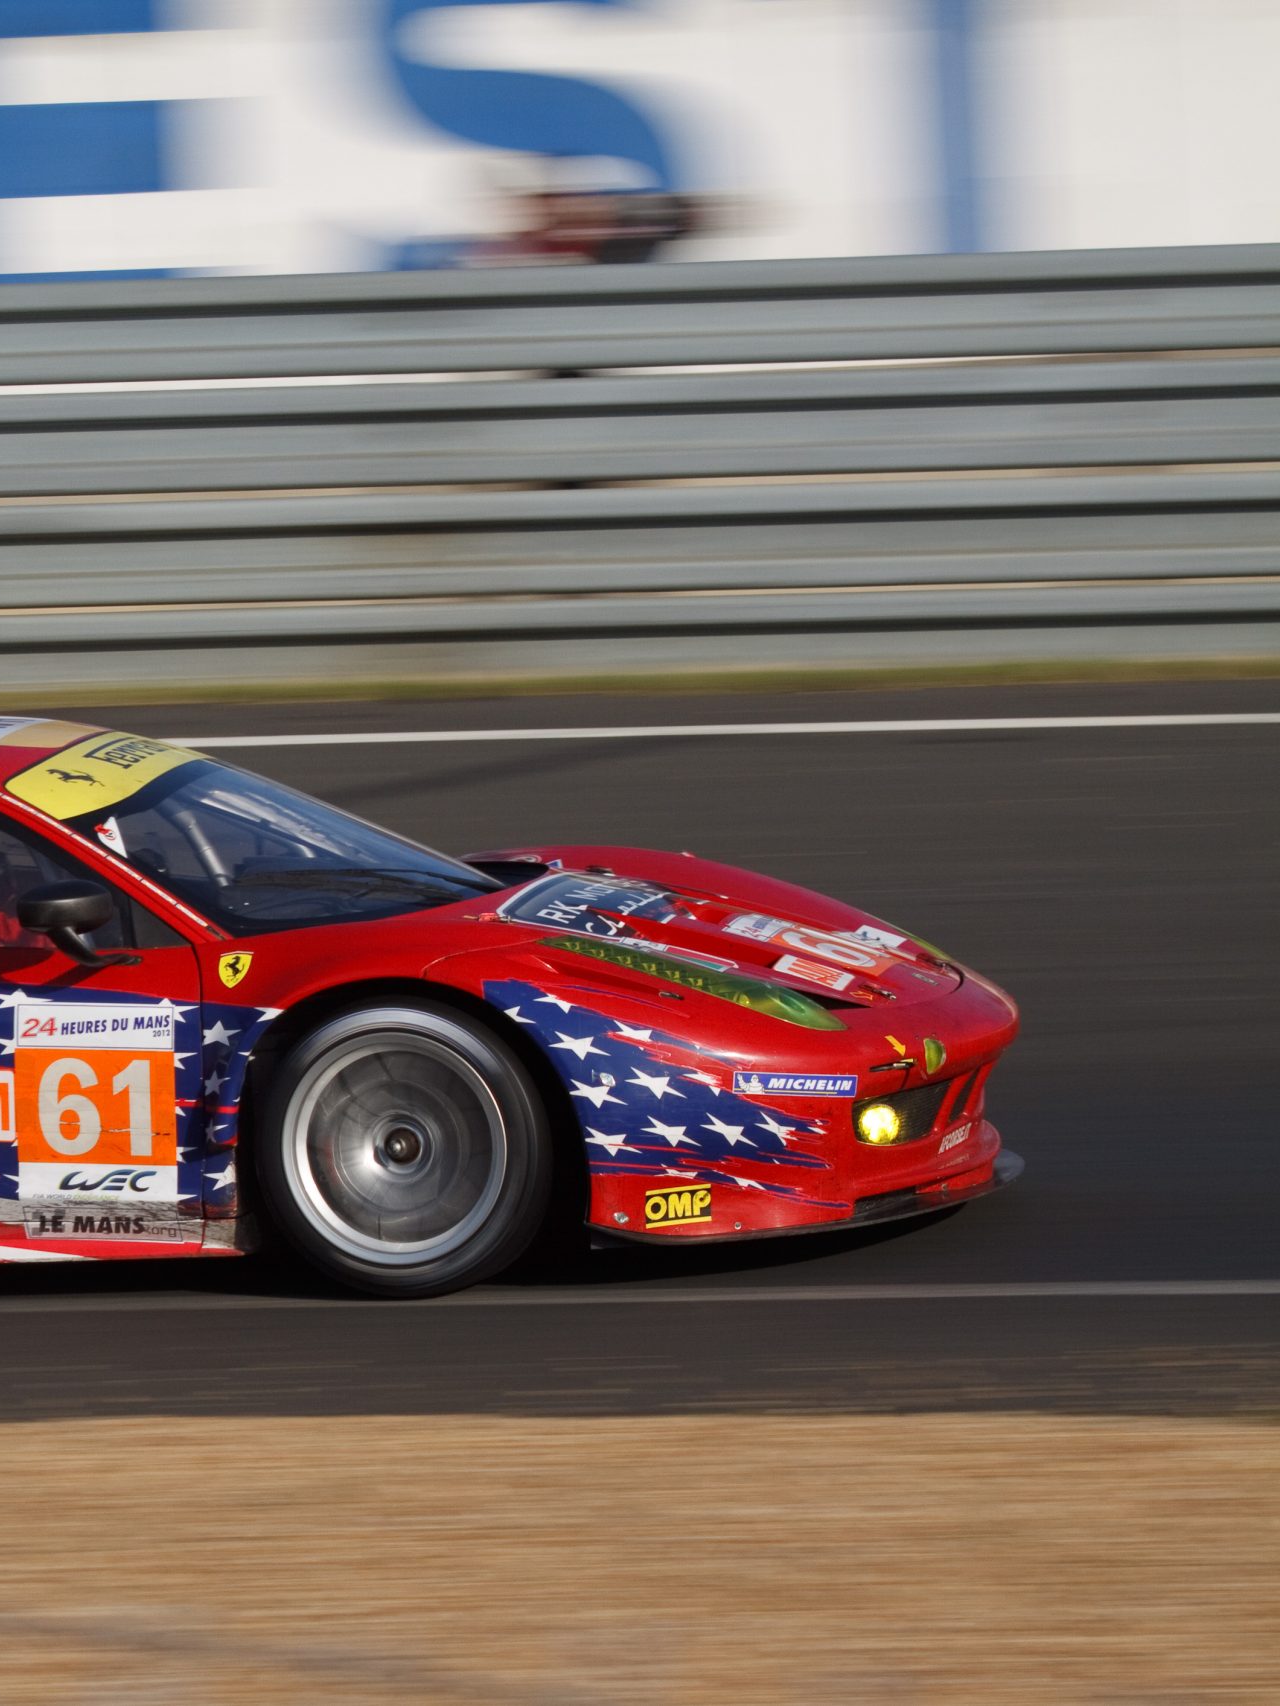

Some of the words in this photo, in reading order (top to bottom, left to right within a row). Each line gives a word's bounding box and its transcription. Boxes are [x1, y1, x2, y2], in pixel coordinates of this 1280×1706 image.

[536, 900, 589, 924] RK
[21, 1017, 58, 1038] 24
[61, 1019, 107, 1036] HEURES
[111, 1018, 129, 1031] DU
[132, 1014, 170, 1030] MANS
[152, 1029, 171, 1038] 2012
[767, 1077, 853, 1091] MICHELIN
[38, 1057, 153, 1157] 61
[58, 1168, 157, 1193] WEC
[645, 1189, 712, 1221] OMP
[72, 1215, 145, 1235] MANS
